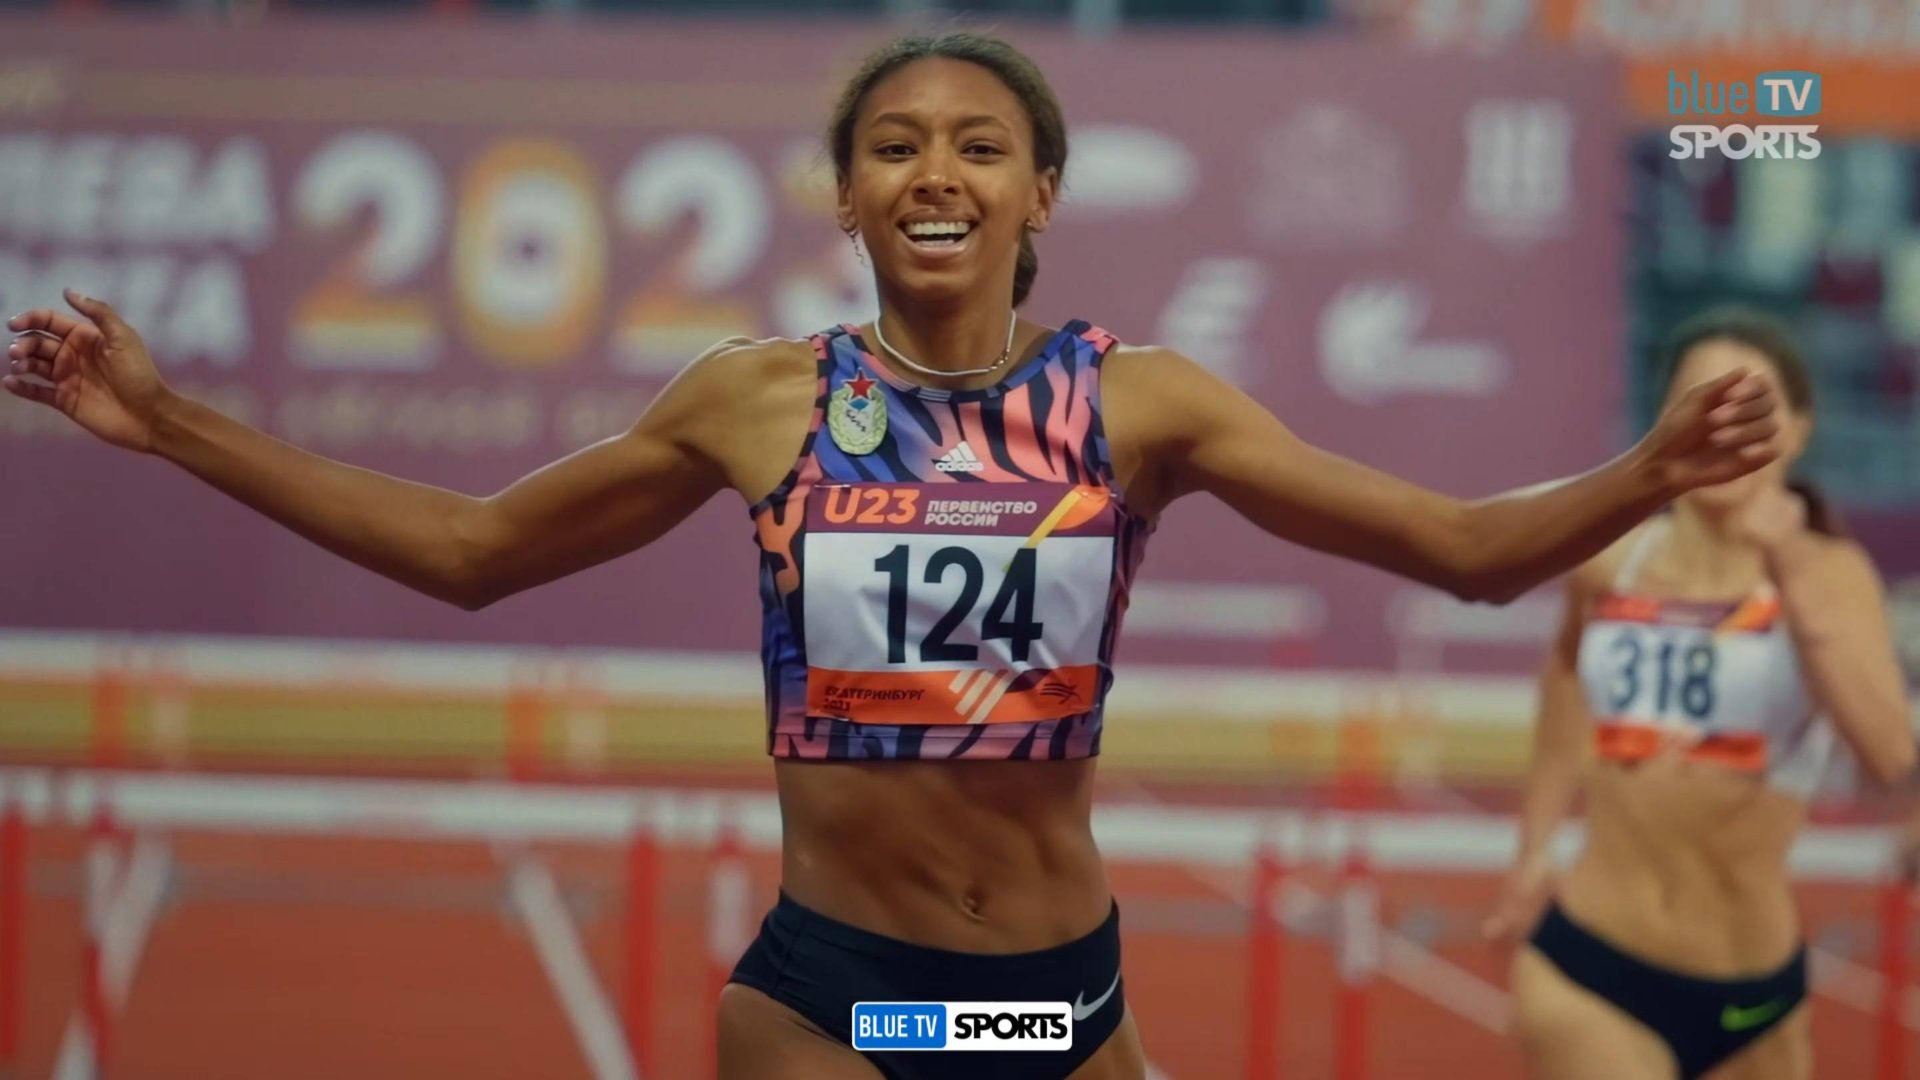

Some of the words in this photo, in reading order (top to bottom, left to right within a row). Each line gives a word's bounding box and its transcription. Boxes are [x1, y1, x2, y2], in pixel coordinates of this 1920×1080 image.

[824, 486, 920, 525] U23
[924, 512, 998, 527] РОССИИ
[926, 500, 1037, 515] ПЕРВЕНСТВО
[873, 544, 1044, 665] 124
[1608, 627, 1717, 720] 318
